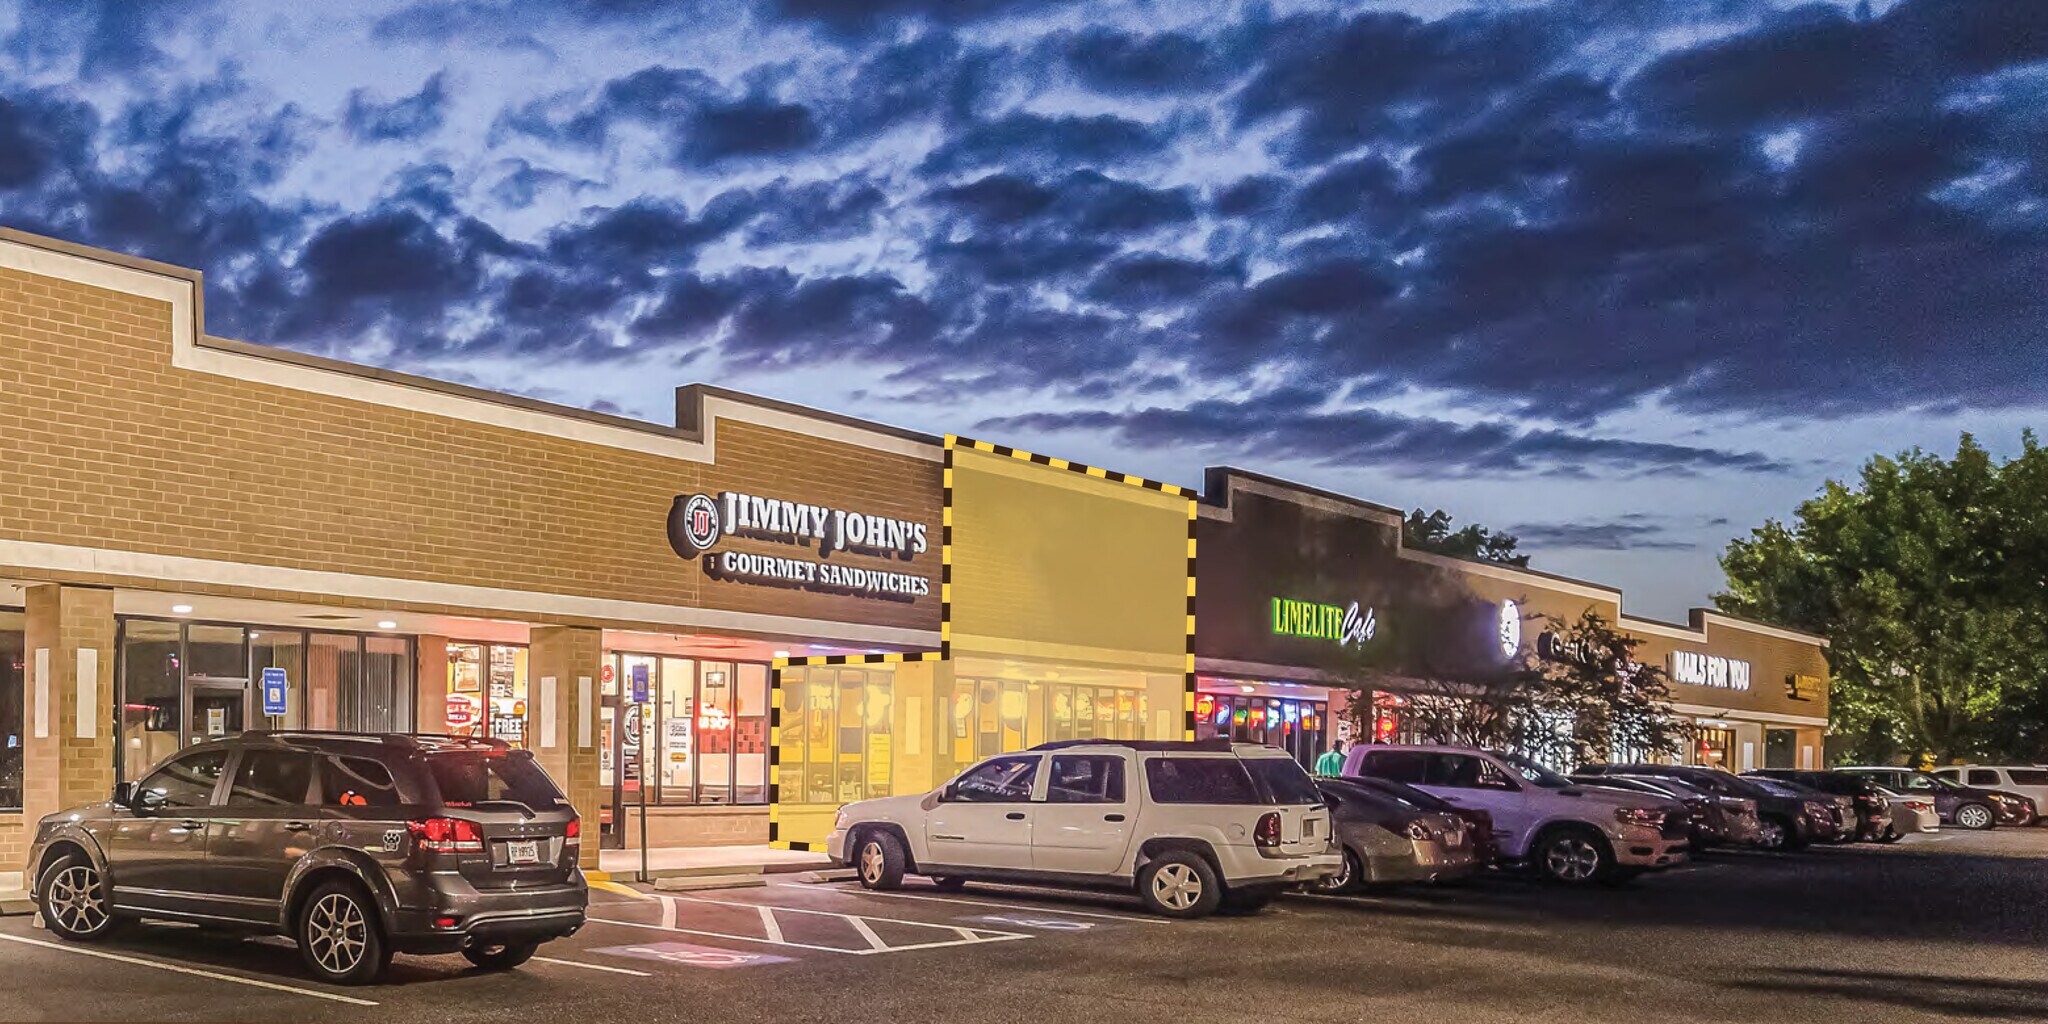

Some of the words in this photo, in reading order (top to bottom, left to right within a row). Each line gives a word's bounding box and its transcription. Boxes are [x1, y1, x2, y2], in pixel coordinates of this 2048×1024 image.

[724, 491, 829, 539] JIMMY
[834, 509, 928, 554] JOHN'S
[722, 551, 817, 580] GOURMET
[819, 563, 929, 596] SANDWICHES
[1272, 596, 1344, 640] LIMELITE
[1340, 600, 1376, 646] Cafe
[1672, 650, 1707, 686] NAILS
[1706, 655, 1728, 688] FOR
[1728, 659, 1750, 690] YOU
[495, 718, 522, 734] FREE
